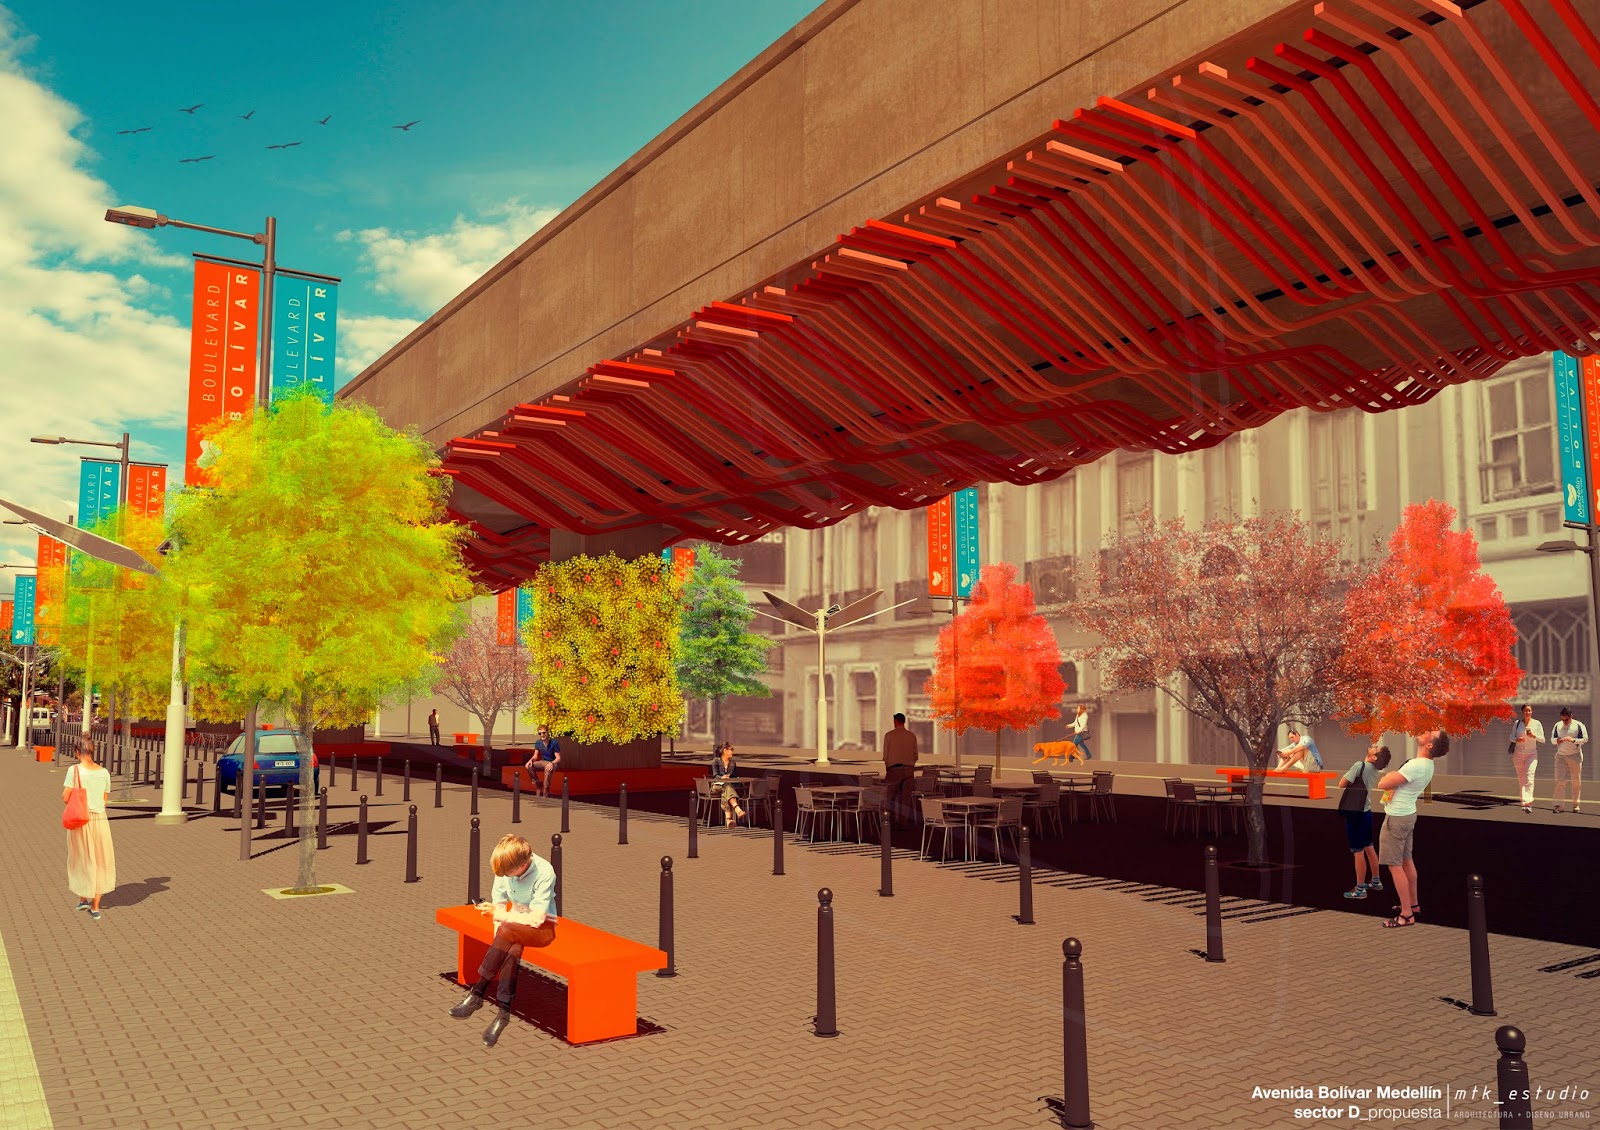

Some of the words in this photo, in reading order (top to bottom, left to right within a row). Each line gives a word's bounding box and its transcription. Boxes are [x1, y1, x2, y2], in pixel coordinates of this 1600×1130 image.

[202, 285, 220, 402] BOULEVARD
[229, 274, 248, 421] BOLÍVAR
[310, 287, 327, 383] LÍVAR
[1558, 359, 1571, 453] BOULEVARD
[1568, 355, 1582, 469] BOLÍVA
[1587, 368, 1599, 460] BOULEVARD
